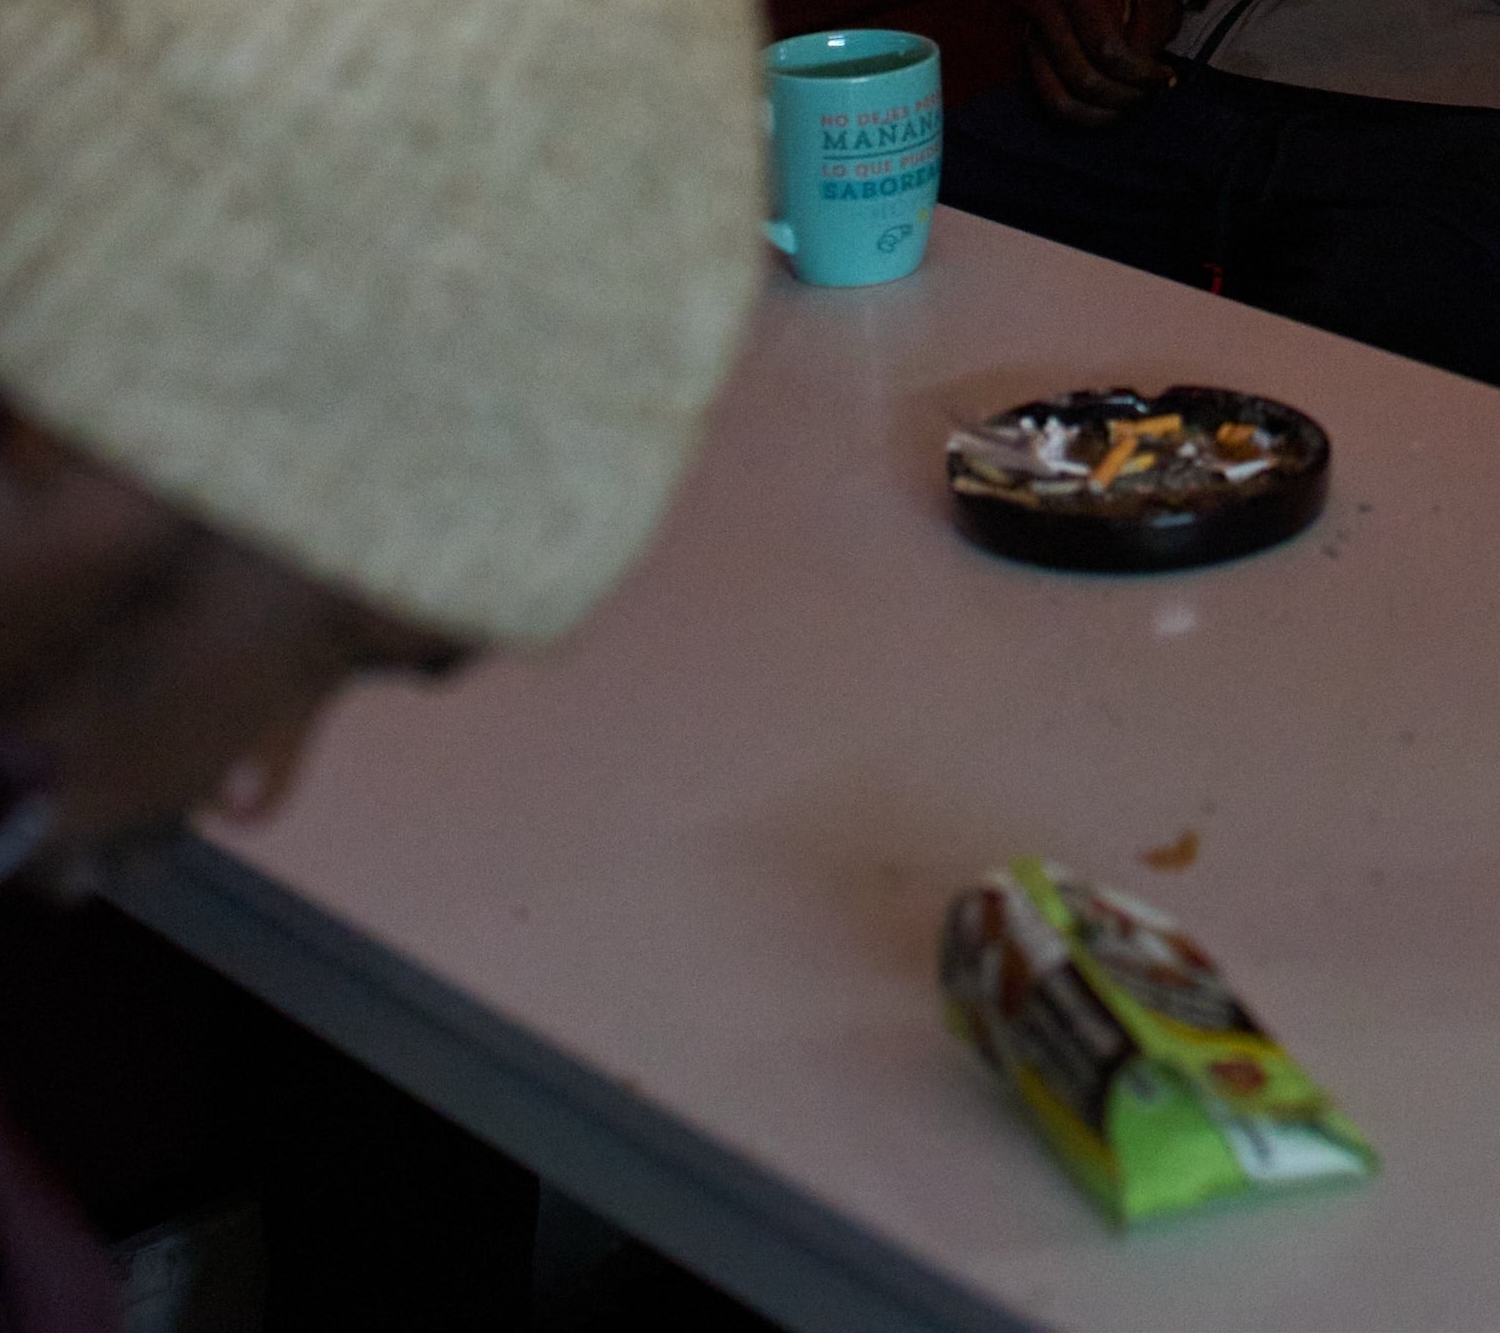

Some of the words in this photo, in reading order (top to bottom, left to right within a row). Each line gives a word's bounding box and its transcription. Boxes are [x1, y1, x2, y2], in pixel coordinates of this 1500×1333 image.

[821, 114, 848, 129] NO
[822, 163, 847, 178] LO
[855, 158, 892, 178] QUE
